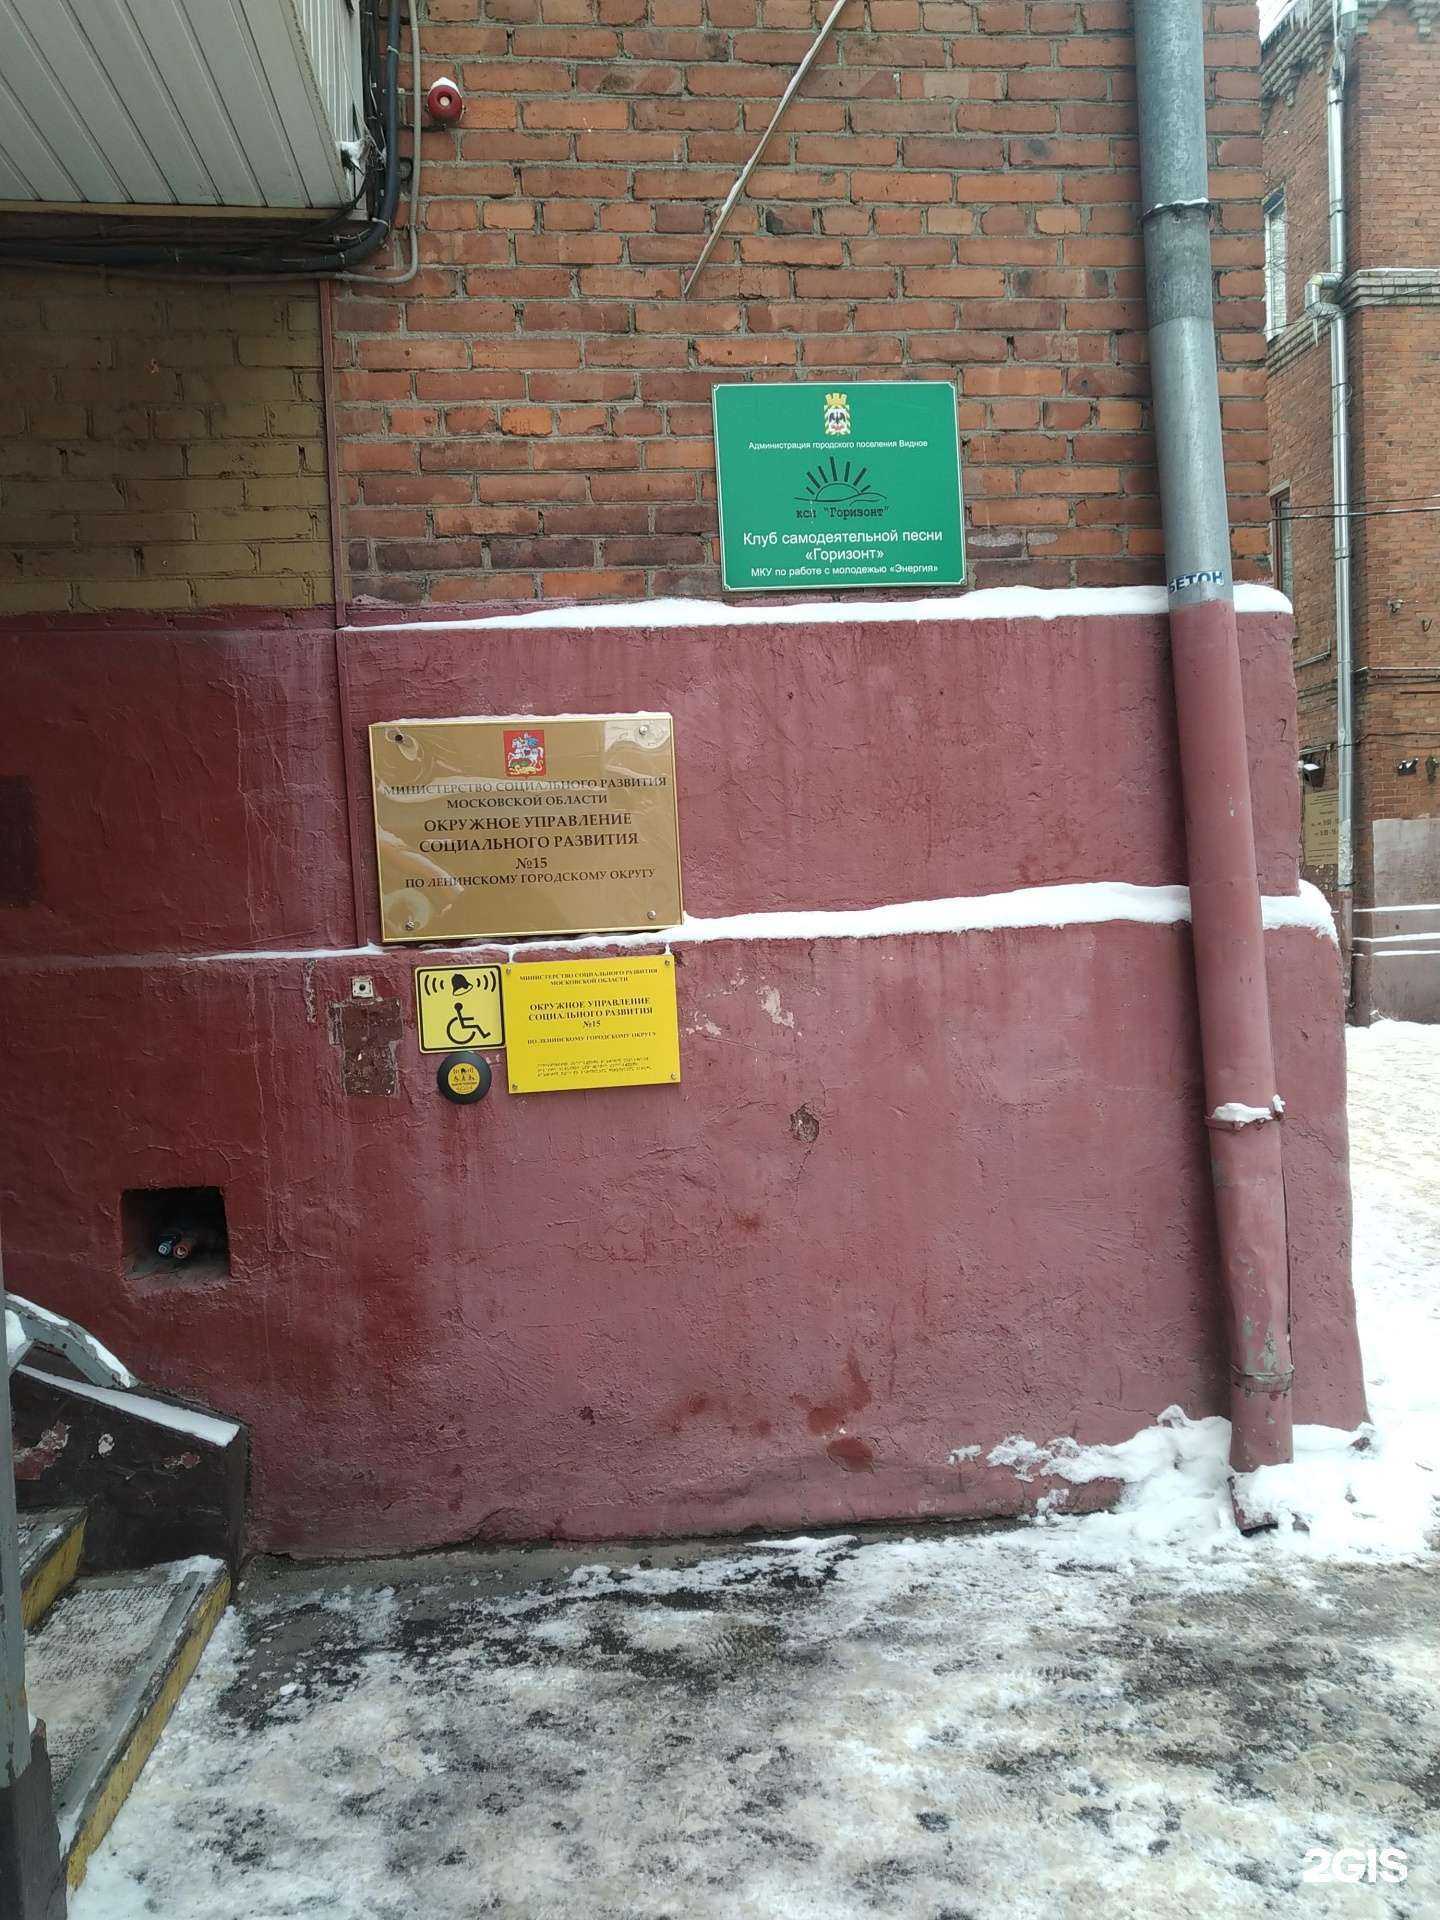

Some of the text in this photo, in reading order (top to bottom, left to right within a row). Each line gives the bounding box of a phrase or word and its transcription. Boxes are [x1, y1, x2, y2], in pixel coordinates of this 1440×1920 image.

[748, 439, 928, 451] Администрация городского поселения Видное
[824, 506, 889, 520] "Горизонт"
[743, 529, 943, 547] Клуб самодеятельной песни
[805, 548, 884, 563] «Горизонт»
[751, 567, 773, 577] МКУ
[775, 568, 787, 577] по
[789, 567, 822, 578] работе
[832, 565, 887, 575] молодежью
[890, 564, 939, 575] «Энергия»
[1168, 571, 1223, 592] БЕТОН
[383, 776, 667, 796] МИНИСТЕРСТВО СОЦИАЛЬНОГО РАЗВИТИЯ
[447, 794, 608, 809] МОСКОВСКОЙ ОБЛАСТИ
[424, 812, 632, 832] ОКРУЖНОЕ УПРАВЛЕНИЕ
[419, 832, 639, 854] СОЦИАЛЬНОГО РАЗВИТИЯ
[515, 856, 548, 870] №15
[405, 868, 656, 888] ПО ЛЕНИНСКОМУ ГОРОДСКОМУ ОКРУГУ
[530, 997, 650, 1011] ОКРУЖНОЕ УПРАВЛЕНИЕ
[528, 1007, 653, 1021] СОЦИАЛЬНОГО РАЗВИТИЯ
[583, 1020, 601, 1029] №15
